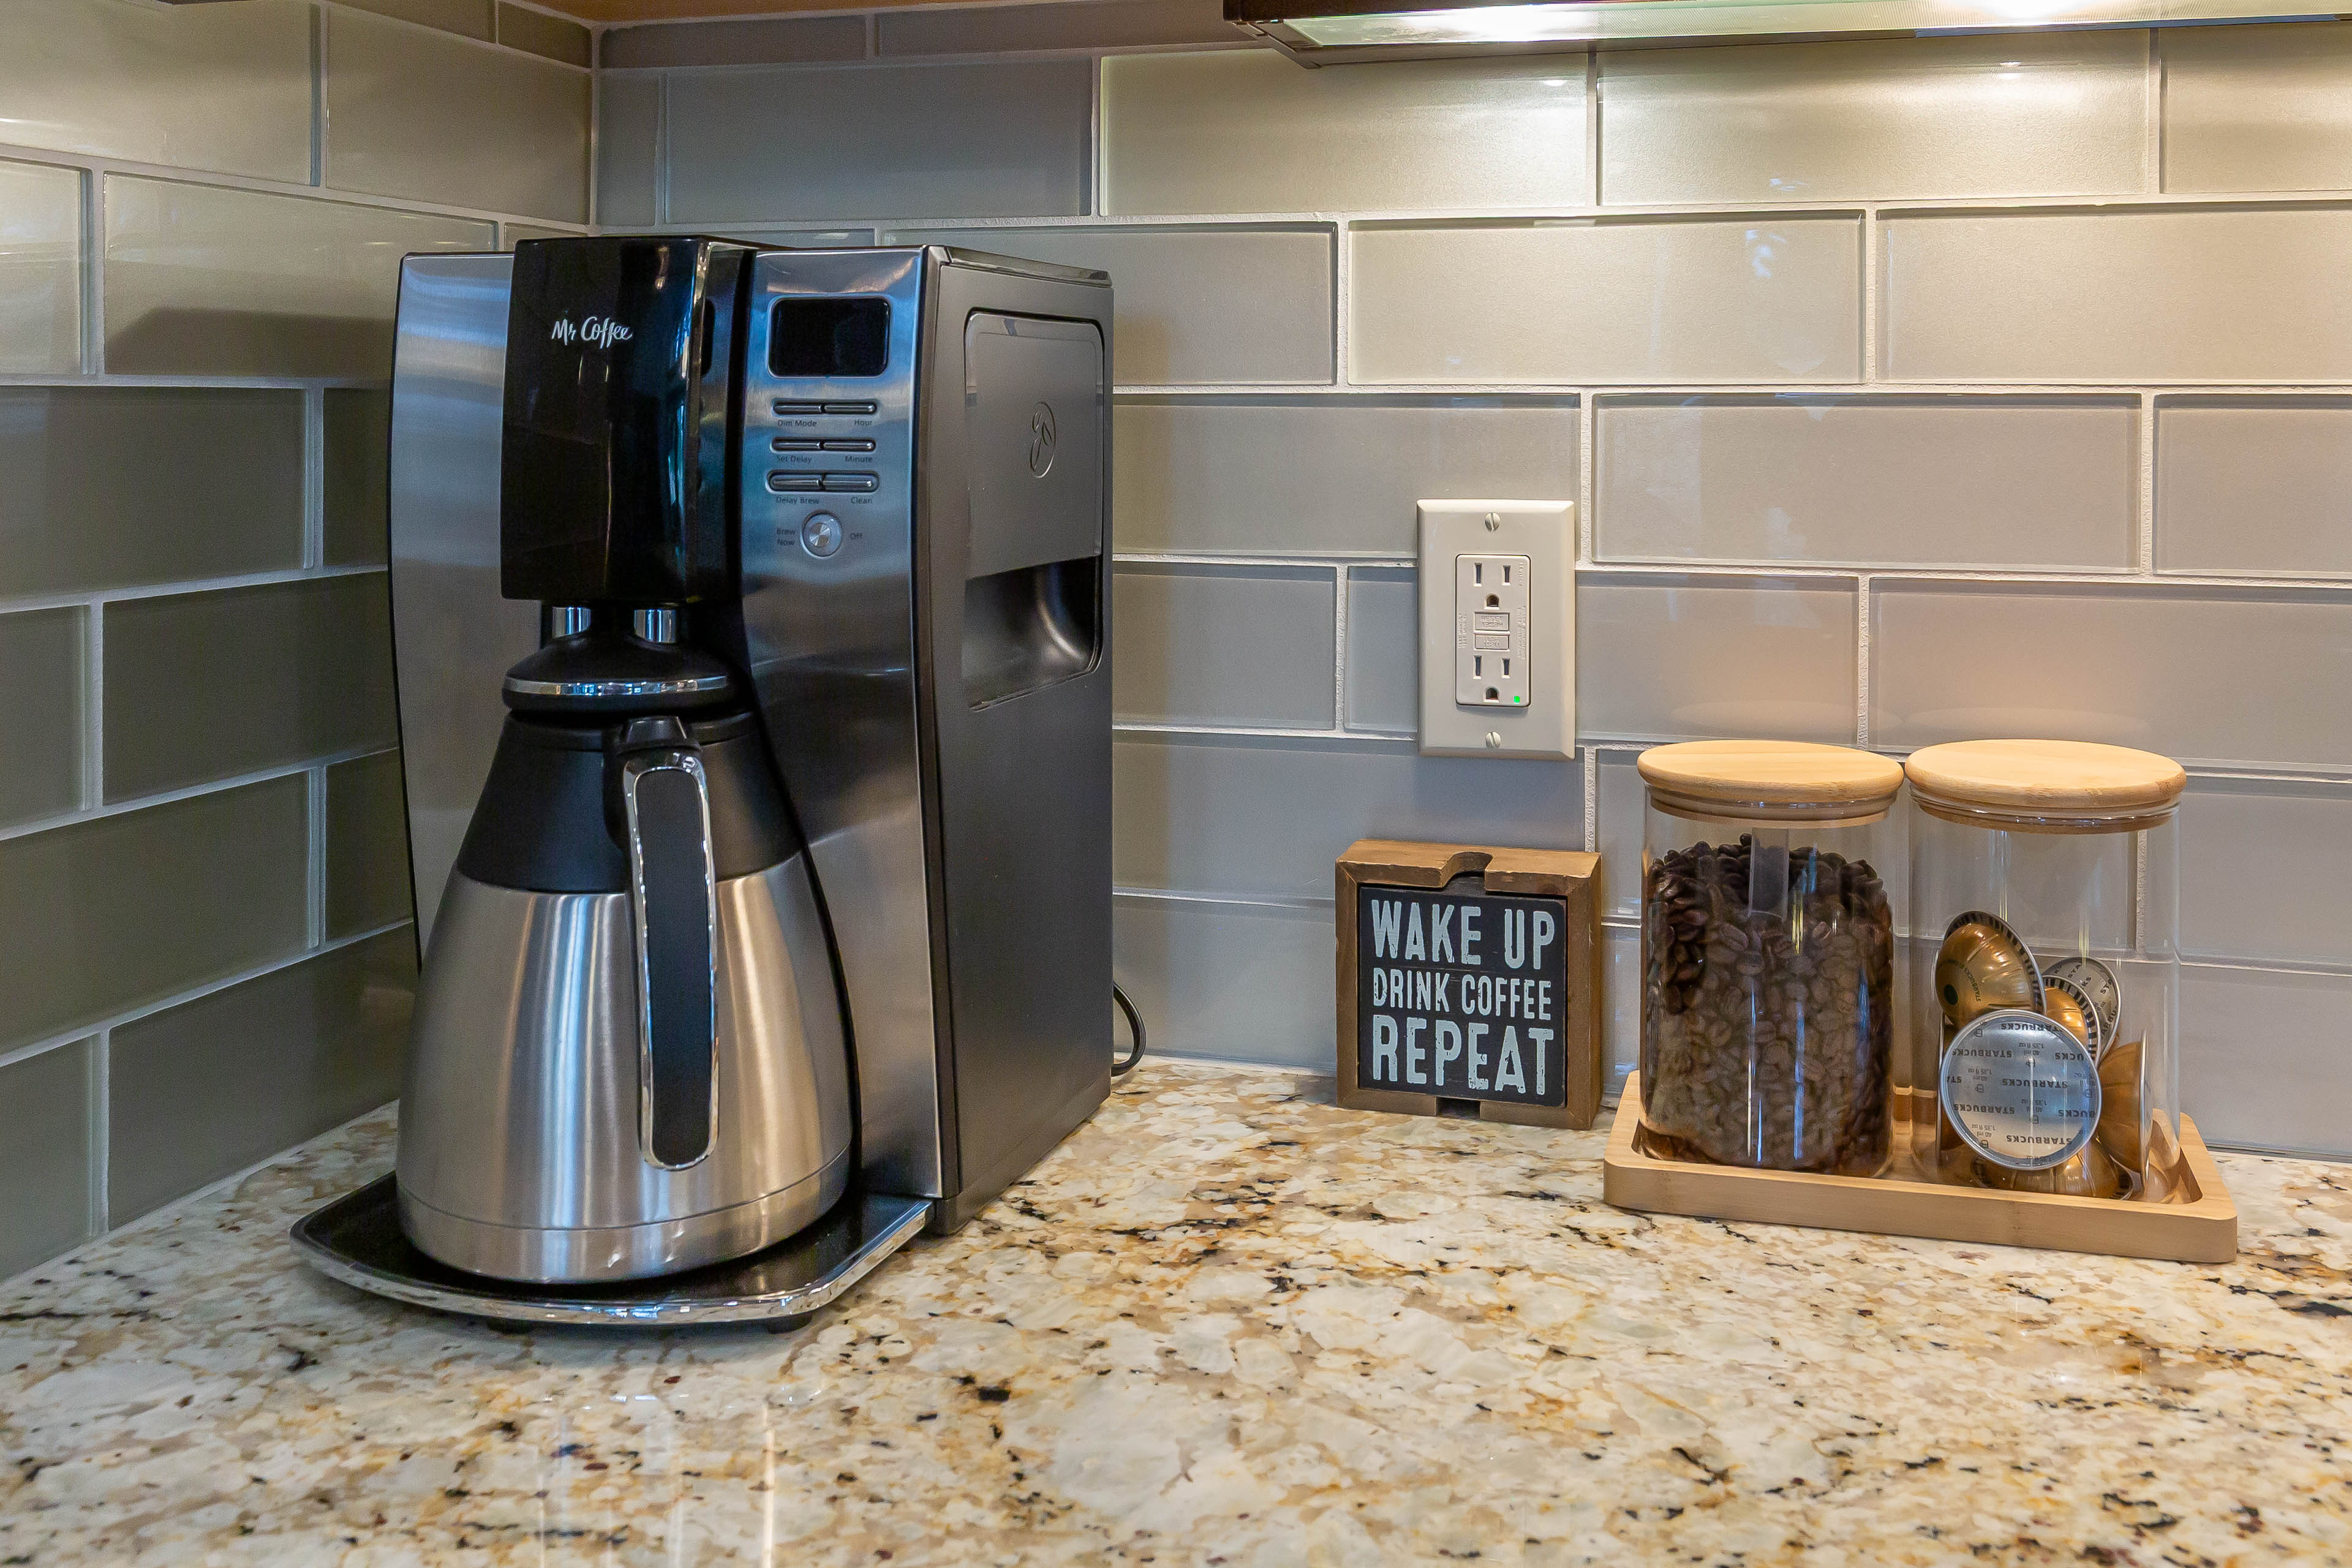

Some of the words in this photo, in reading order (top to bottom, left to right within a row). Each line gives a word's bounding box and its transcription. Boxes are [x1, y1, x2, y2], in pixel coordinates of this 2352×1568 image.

[581, 316, 633, 350] Coffee
[790, 455, 812, 464] Delay
[776, 497, 797, 505] Delay
[1371, 899, 1481, 965] WAKE
[1504, 908, 1555, 970] UP
[1373, 967, 1450, 1012] DRINK
[1461, 974, 1551, 1020] COFFEE
[1373, 1014, 1554, 1096] REPEAT
[1952, 1048, 2012, 1058] STARBUCKS
[2002, 1079, 2068, 1088] STARBUCKS
[1953, 1104, 2015, 1114] STARBUCKS
[2006, 1135, 2071, 1145] STARBUCKS
